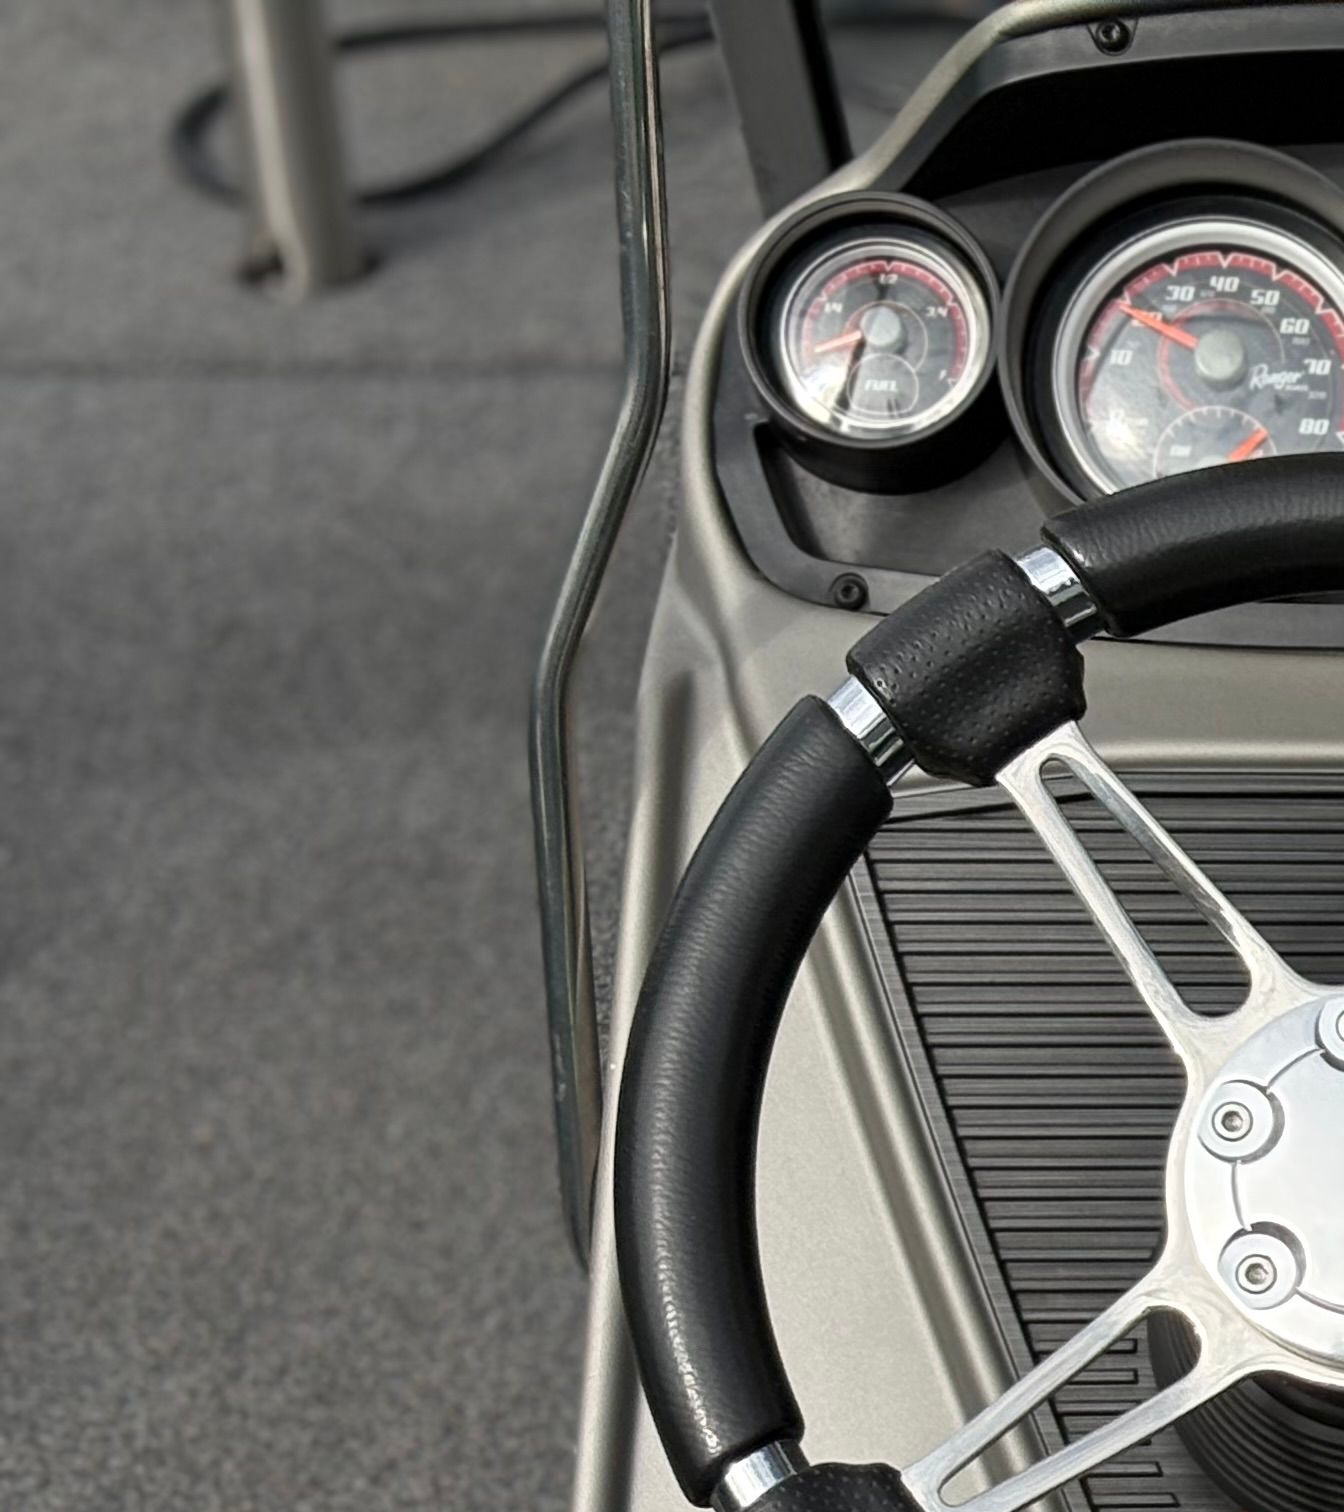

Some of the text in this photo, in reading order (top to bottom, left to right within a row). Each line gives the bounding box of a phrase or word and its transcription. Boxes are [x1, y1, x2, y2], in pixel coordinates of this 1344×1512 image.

[1210, 275, 1240, 292] 40
[1166, 285, 1195, 301] 30
[1250, 290, 1280, 306] 50
[1280, 318, 1310, 335] 60
[1110, 350, 1133, 365] 10
[1303, 358, 1332, 375] 70
[865, 379, 898, 391] FUEL
[1249, 363, 1305, 390] Ranger
[1299, 418, 1329, 435] 80
